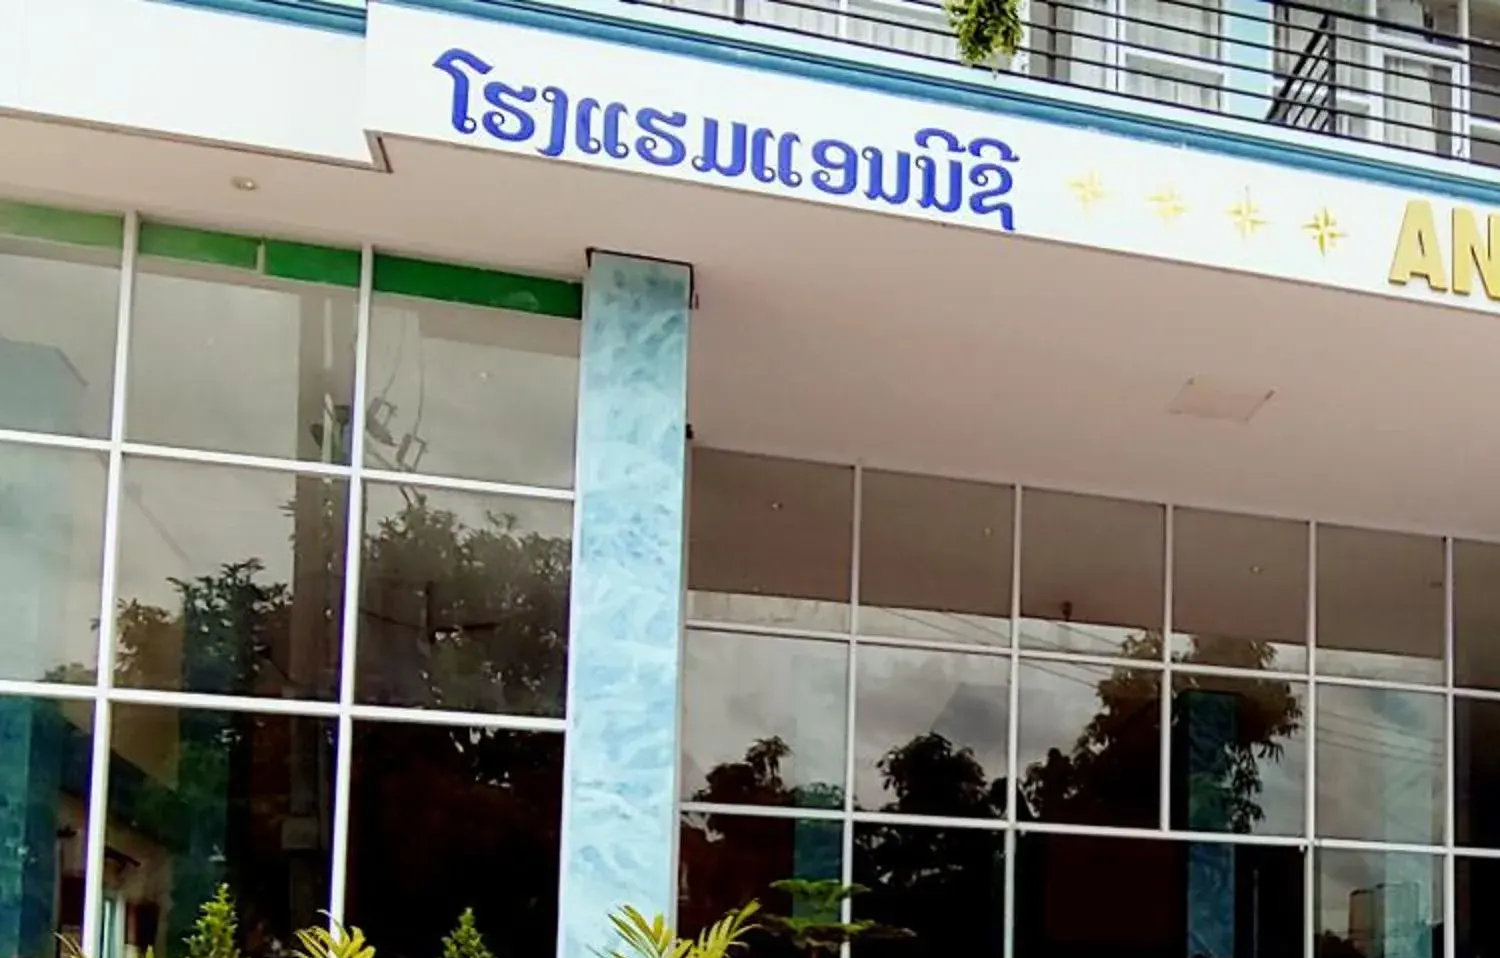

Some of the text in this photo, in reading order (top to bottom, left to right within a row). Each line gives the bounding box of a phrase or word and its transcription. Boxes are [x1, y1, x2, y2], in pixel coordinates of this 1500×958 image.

[432, 48, 1020, 231] ໂຮງແຮມແອນນີຊີ
